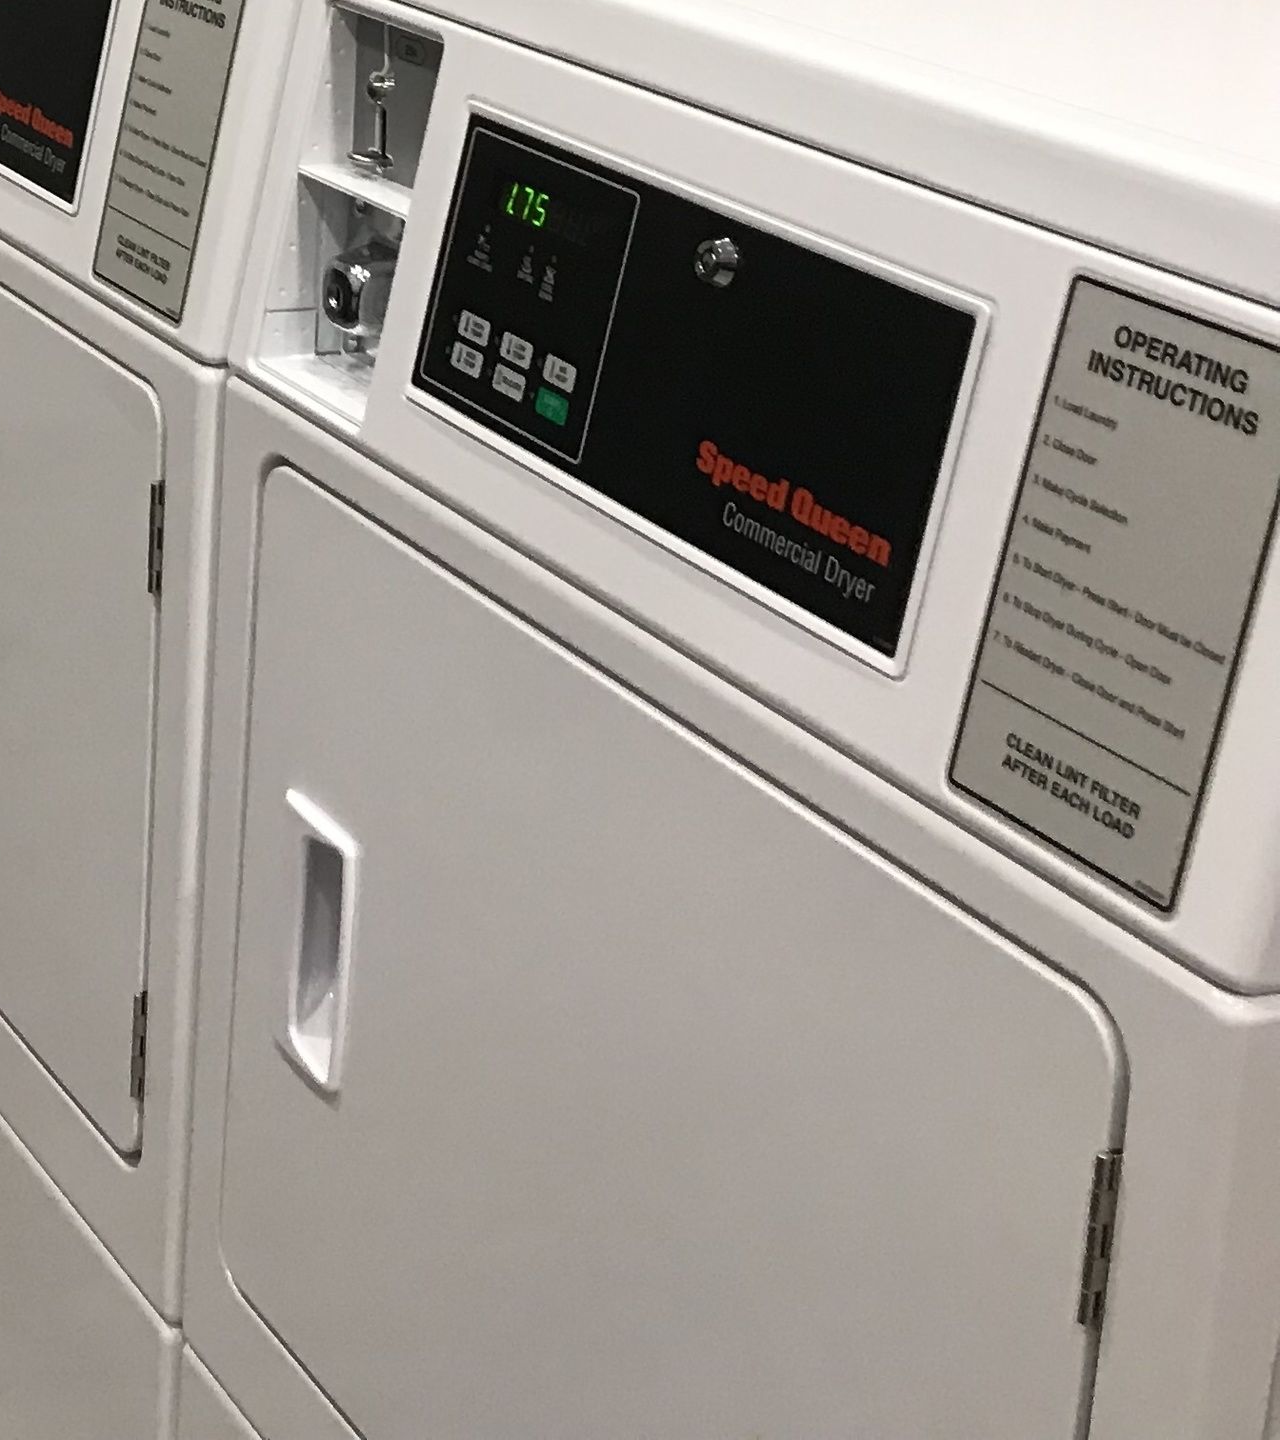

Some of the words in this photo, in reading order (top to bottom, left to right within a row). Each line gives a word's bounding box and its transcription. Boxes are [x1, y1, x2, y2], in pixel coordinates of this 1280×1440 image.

[31, 106, 74, 150] Queen
[1086, 349, 1260, 436] INSTRUCTIONS
[1113, 325, 1250, 395] OPERATING
[696, 439, 790, 513] Speed
[790, 486, 894, 569] Queen
[721, 501, 822, 576] Commercial
[823, 555, 877, 604] Dryer
[1001, 754, 1049, 791] AFTER
[1050, 781, 1091, 815] EACH
[1092, 805, 1136, 840] LOAD
[1006, 732, 1054, 770] CLEAN
[1056, 760, 1089, 790] LINT
[1090, 780, 1141, 821] FILTER
